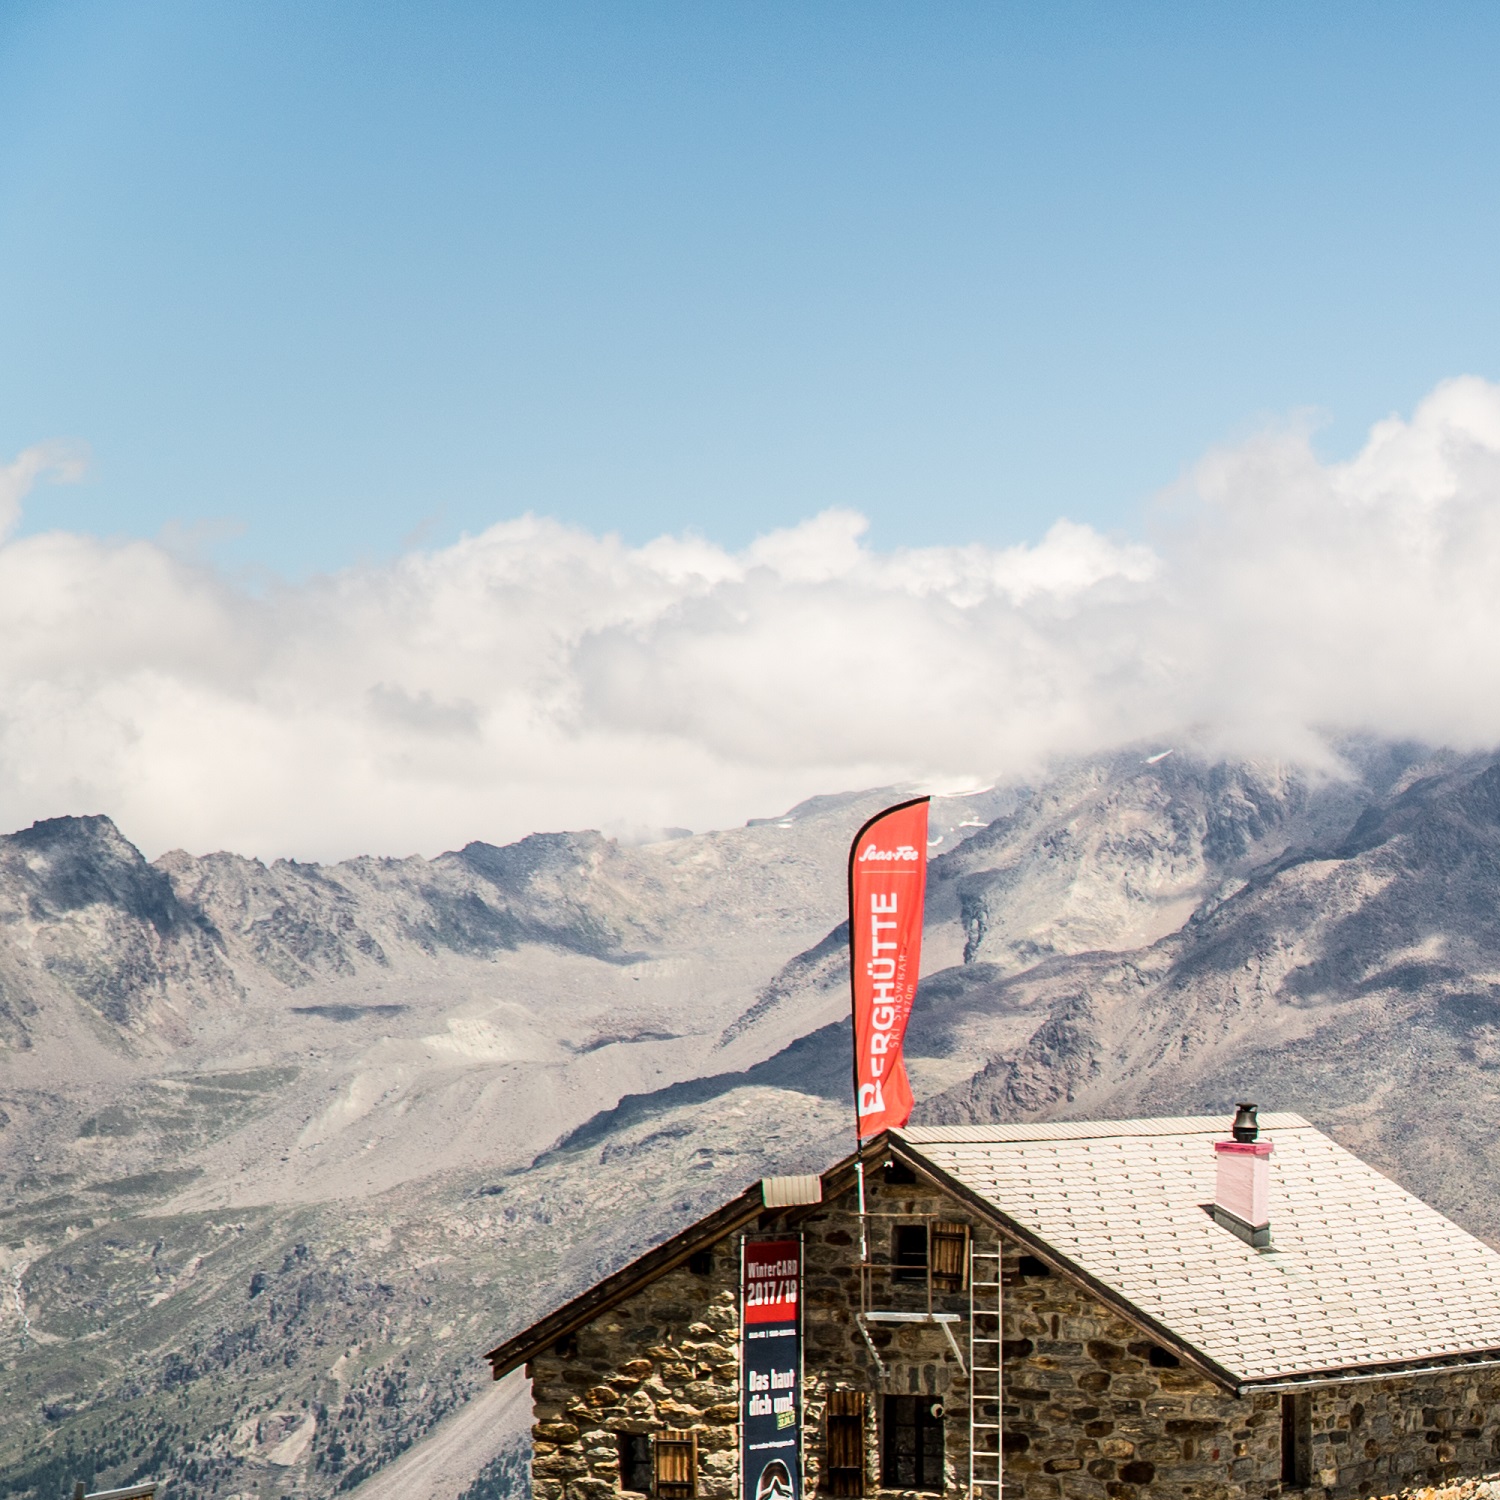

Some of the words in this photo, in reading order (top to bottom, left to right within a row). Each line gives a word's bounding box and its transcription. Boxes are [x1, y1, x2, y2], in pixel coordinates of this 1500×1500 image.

[858, 843, 919, 862] Saas-Fee
[889, 1027, 901, 1049] SKI
[748, 1259, 798, 1279] WinterCARD
[747, 1279, 798, 1307] 2017/18
[749, 1370, 769, 1392] Das
[749, 1393, 772, 1416] dich
